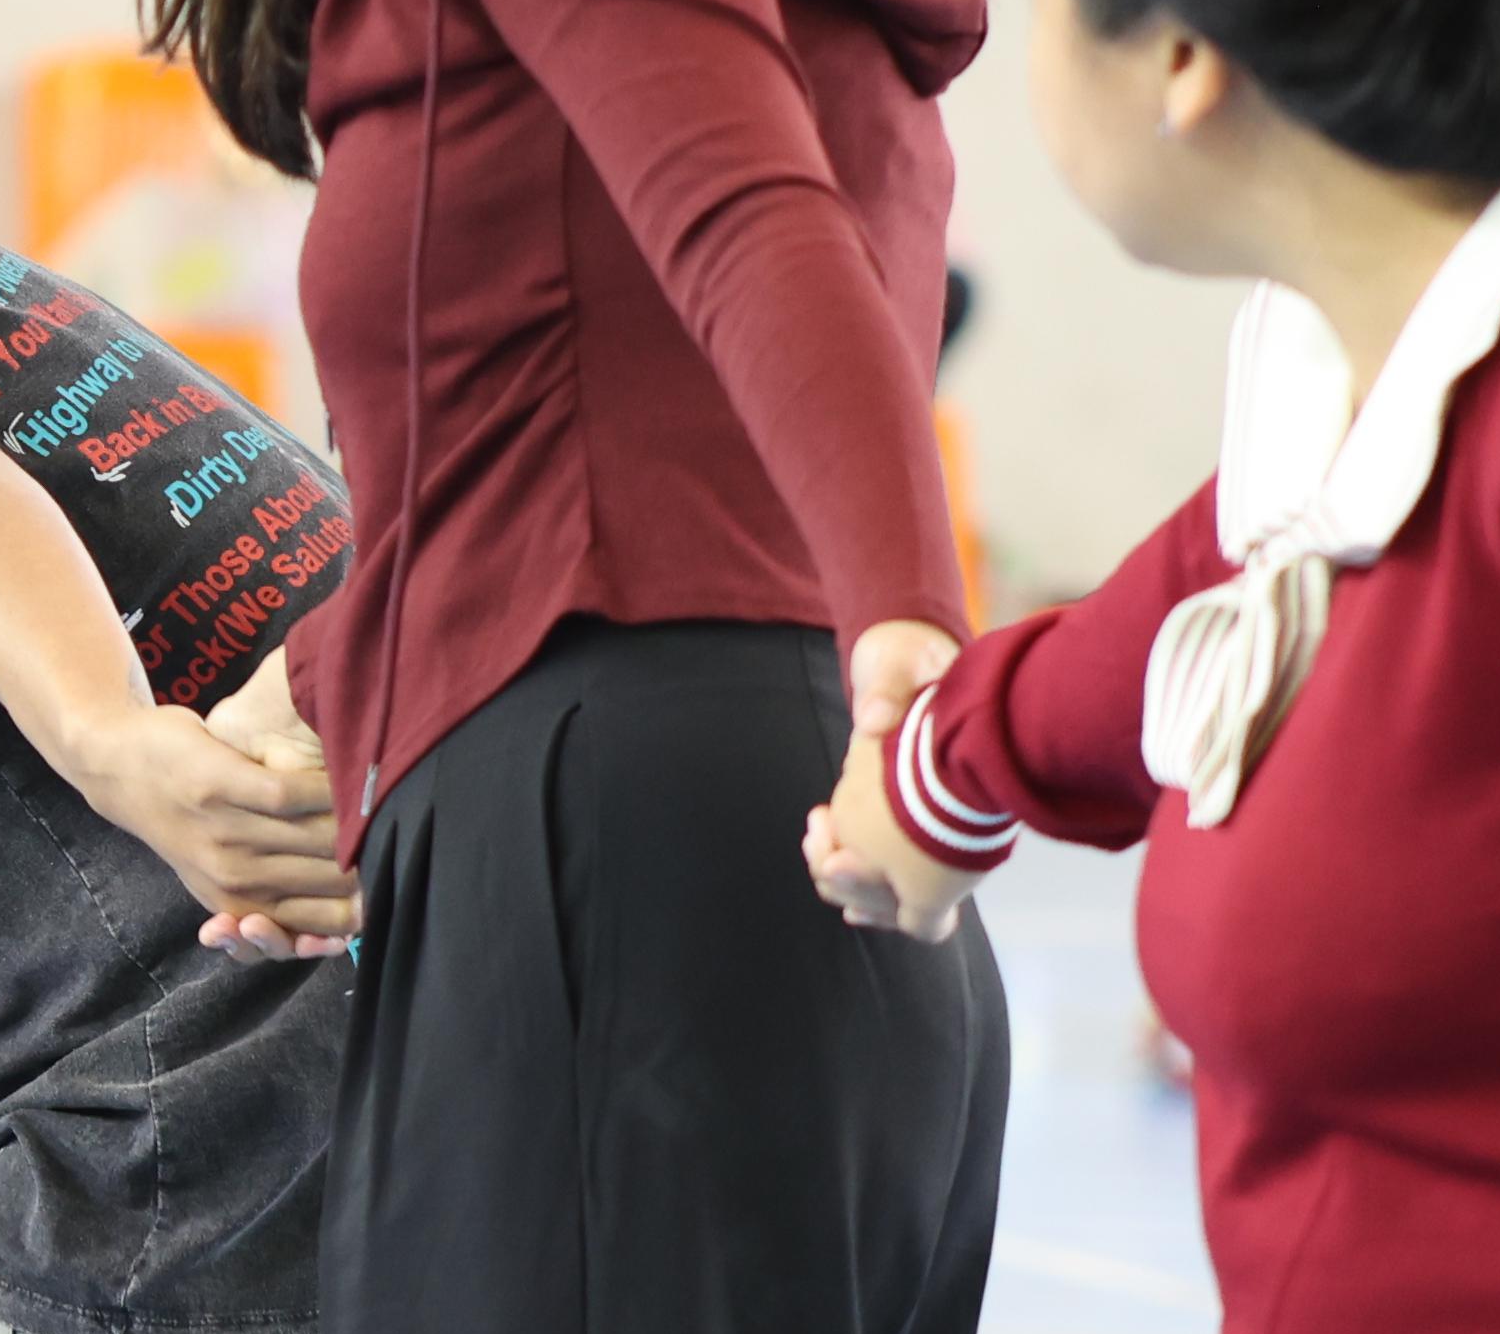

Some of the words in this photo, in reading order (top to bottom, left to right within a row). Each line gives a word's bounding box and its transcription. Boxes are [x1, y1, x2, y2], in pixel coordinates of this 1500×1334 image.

[15, 349, 135, 458] Highway
[78, 409, 168, 473] Back
[152, 397, 197, 427] in
[163, 449, 248, 519] Dirty
[222, 425, 276, 462] Dee
[135, 622, 174, 672] or
[158, 533, 266, 625] Those
